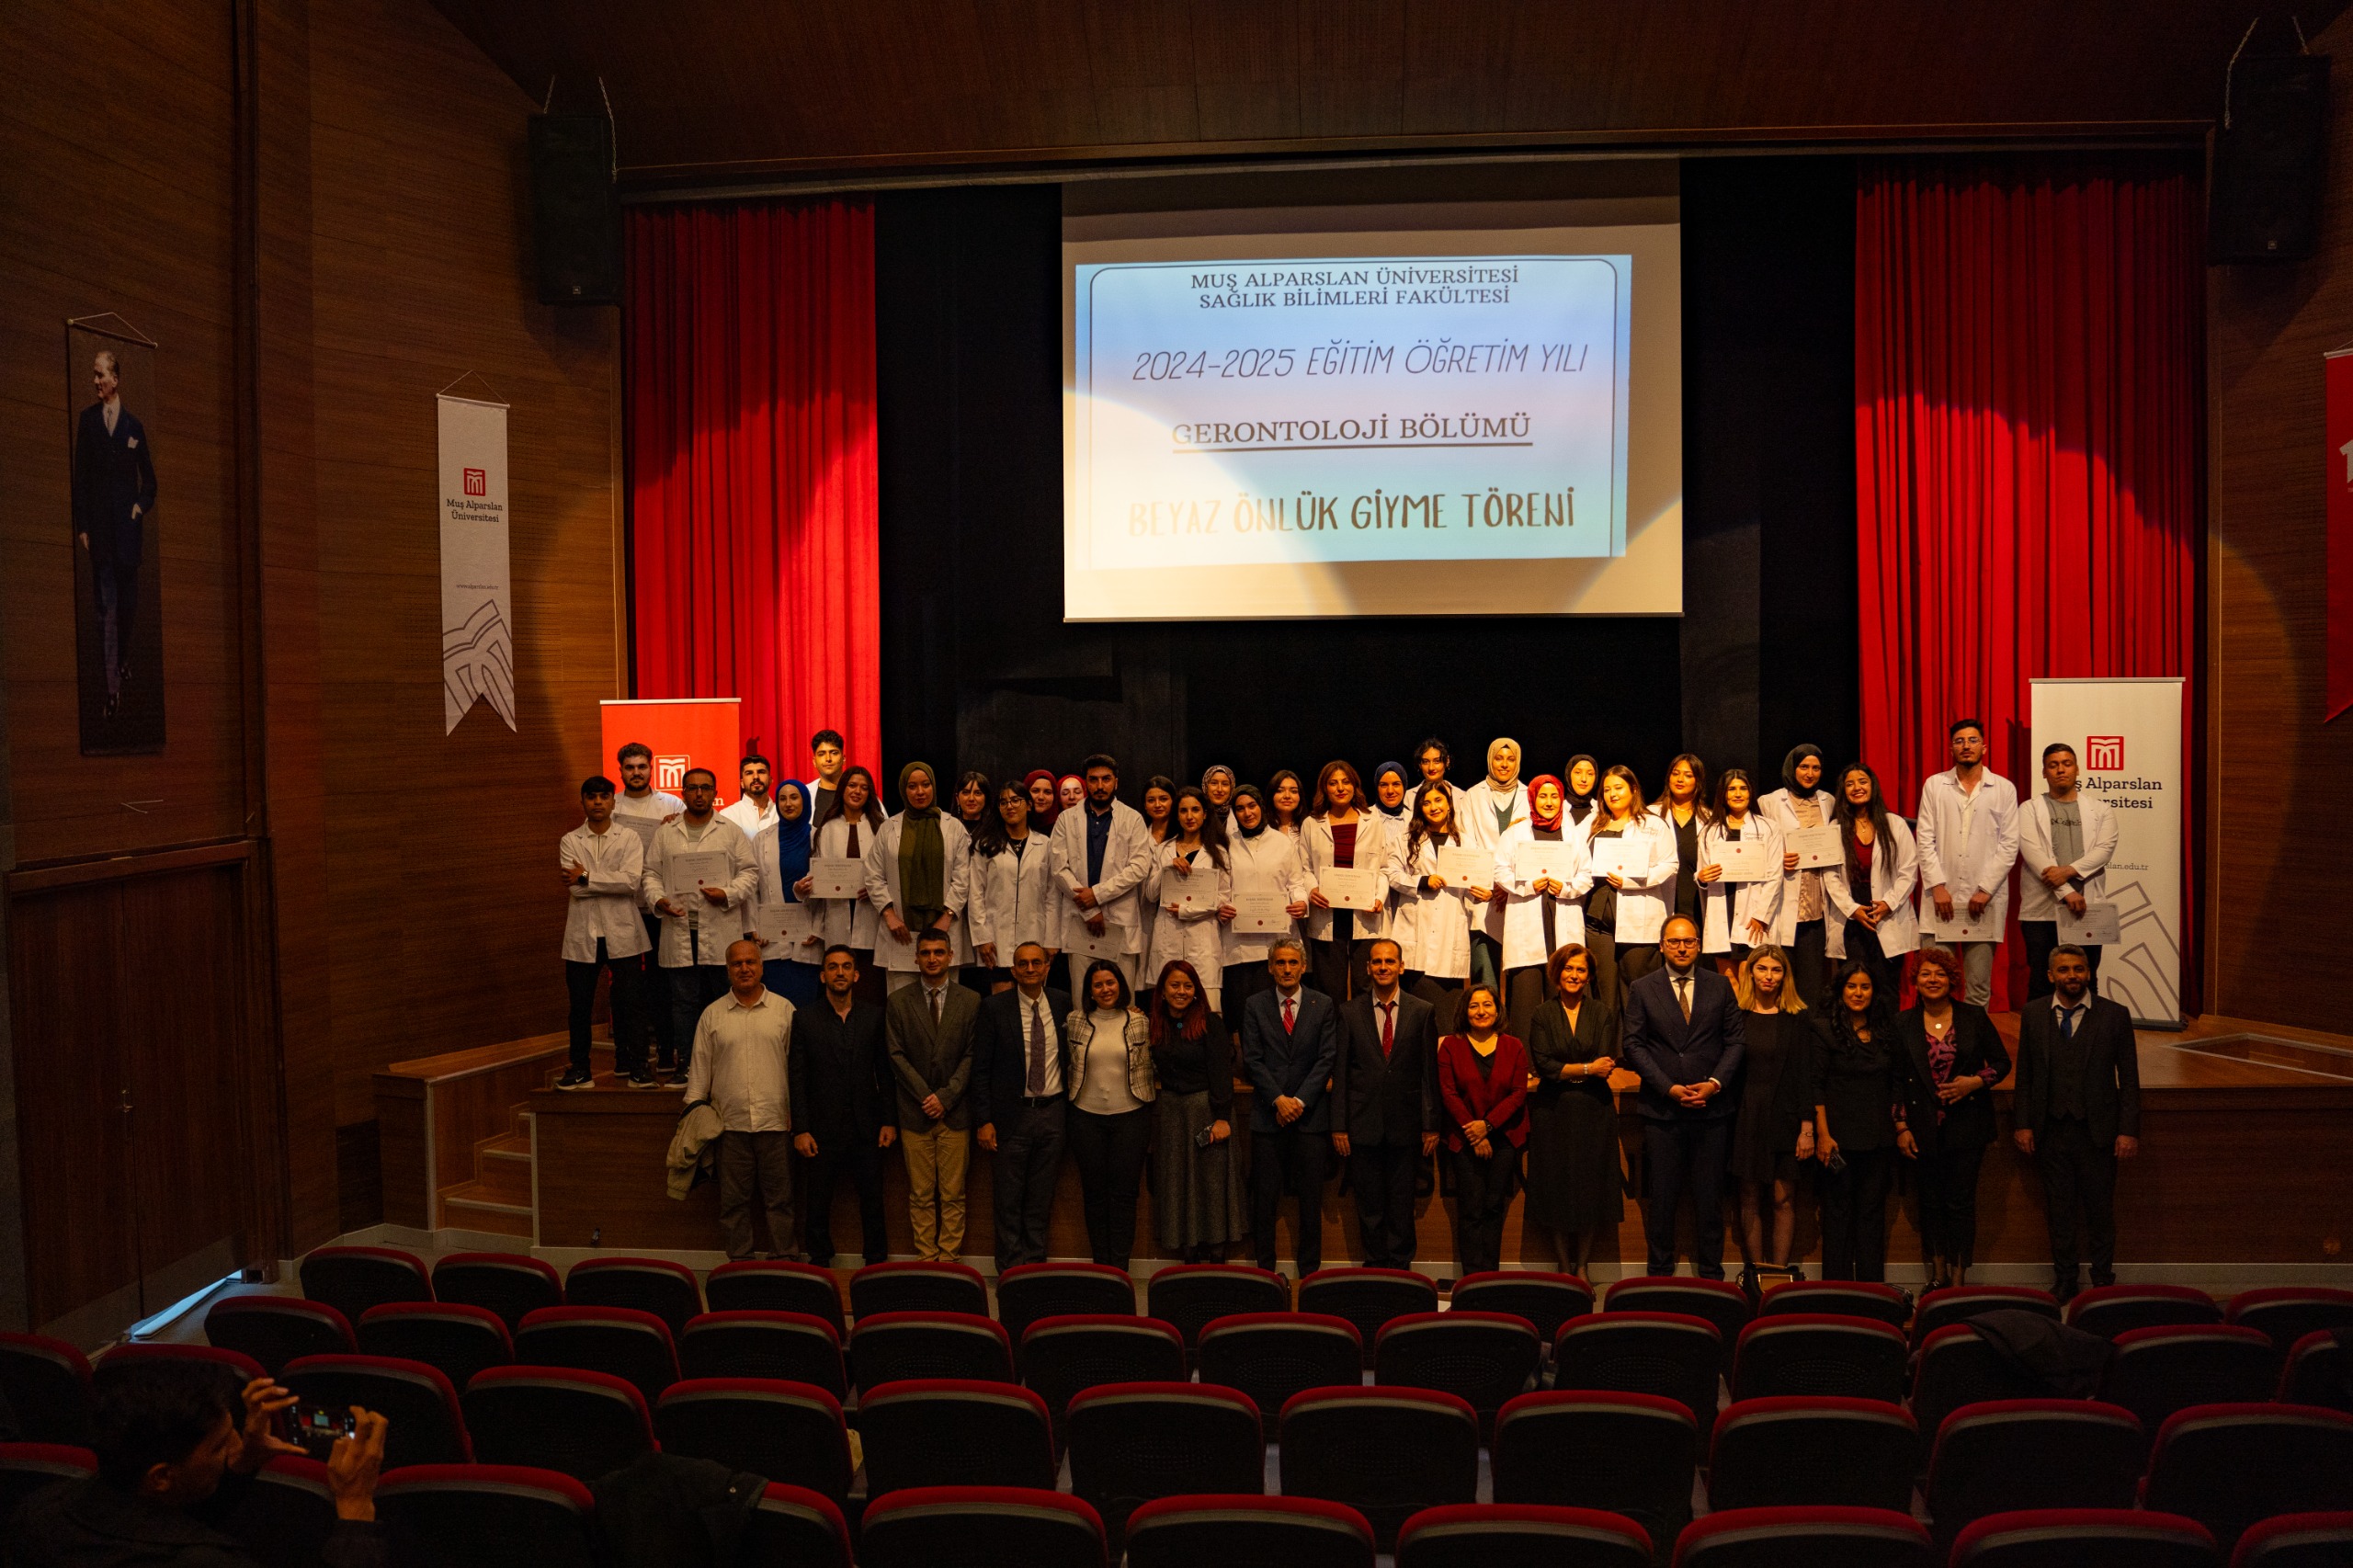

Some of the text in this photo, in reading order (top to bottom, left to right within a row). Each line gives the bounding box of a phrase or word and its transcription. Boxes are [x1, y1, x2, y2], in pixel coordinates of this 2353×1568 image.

[1191, 262, 1518, 292] MUŞ ALPARSLAN ÜNİVERSİTESİ
[1199, 285, 1510, 309] SAĞLIK BİLİMLERİ FAKÜLTESİ
[1132, 337, 1588, 381] 2024-2025 EĞİTİM ÖĞRETİM YILI
[1172, 412, 1531, 444] GERONTOLOJİ BÖLÜMÜ
[447, 498, 503, 511] Muş Alparslan
[451, 511, 499, 523] Üniversitesi
[1129, 485, 1575, 538] BEYAZ ÖNLÜK GİYME TÖRENİ
[2086, 777, 2163, 792] Alparslan
